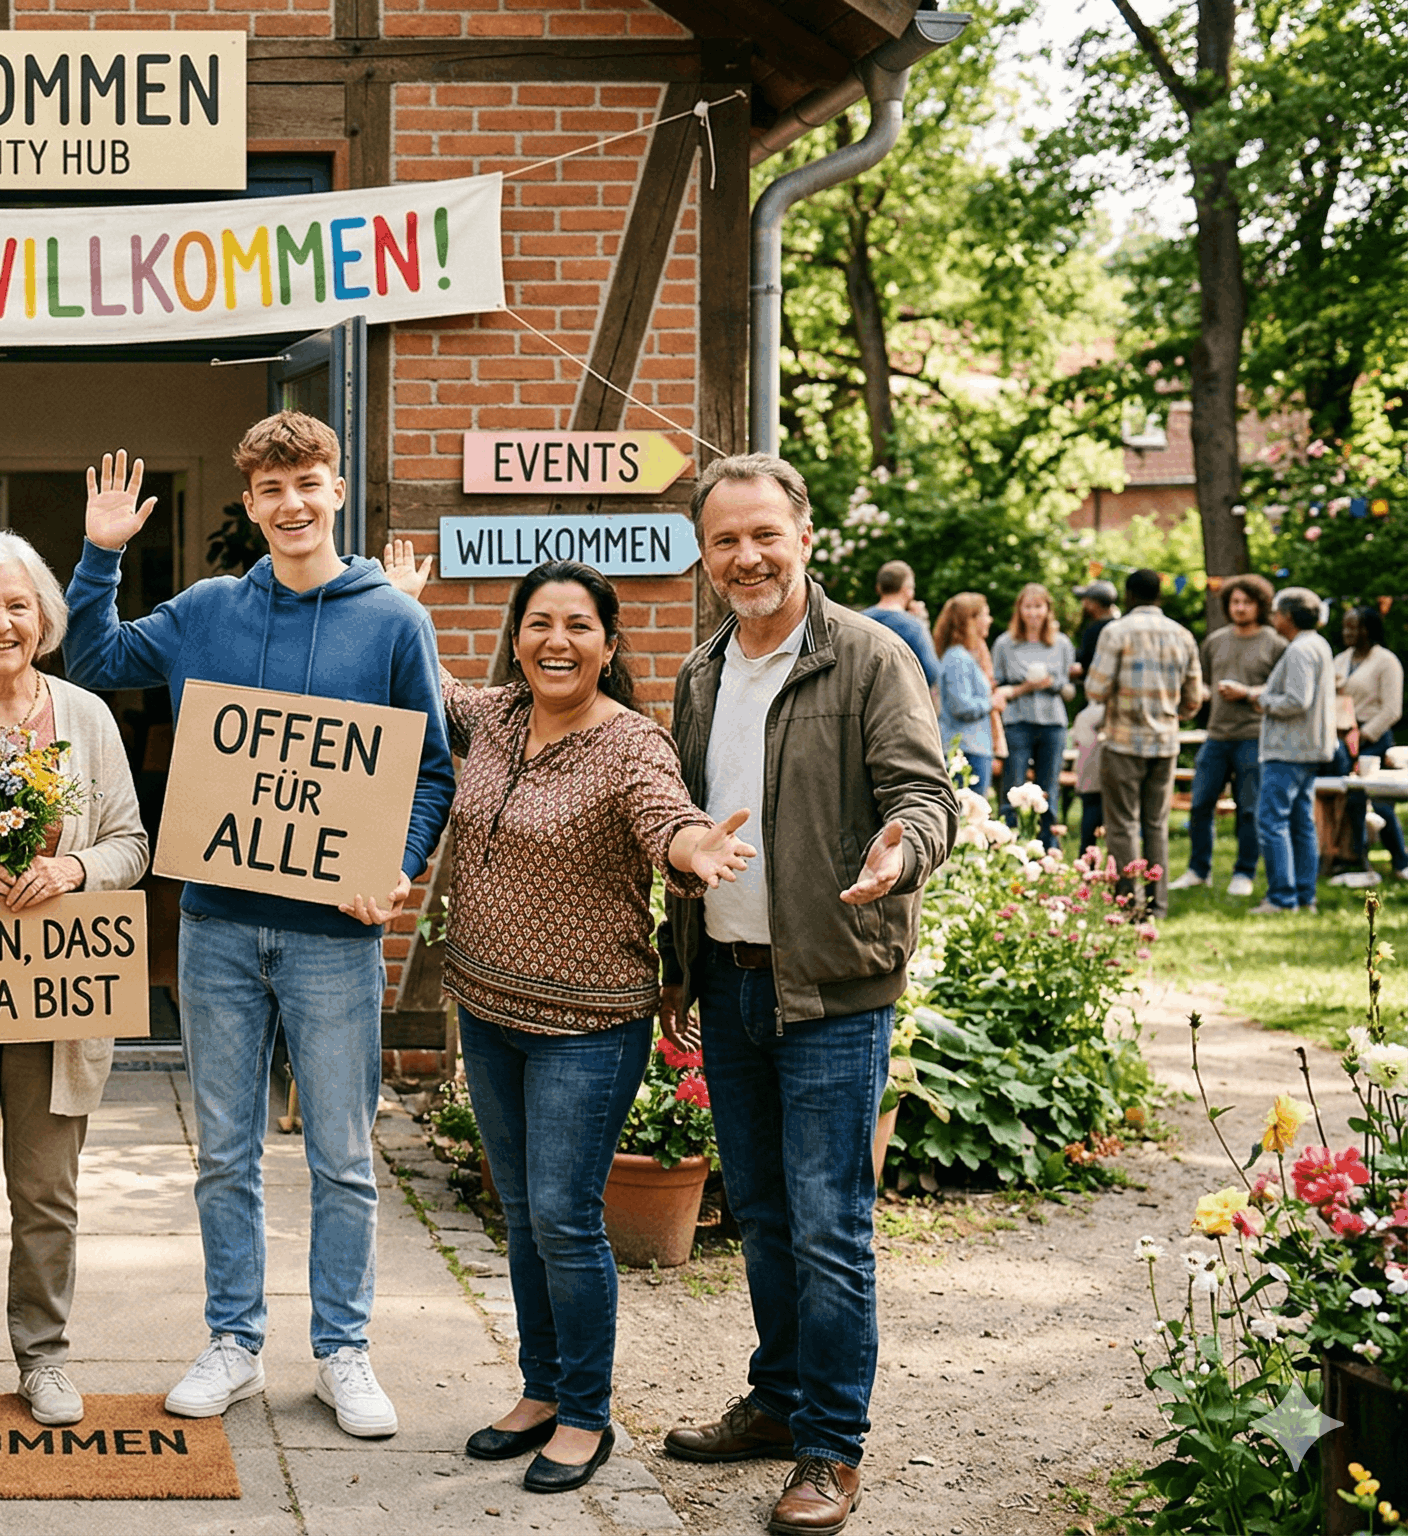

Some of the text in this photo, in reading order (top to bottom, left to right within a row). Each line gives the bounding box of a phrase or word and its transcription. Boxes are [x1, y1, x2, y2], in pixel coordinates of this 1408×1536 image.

[63, 139, 130, 175] HUB
[494, 442, 639, 483] EVENTS
[456, 526, 671, 565] WILLKOMMEN
[213, 703, 383, 776] OFFEN
[253, 769, 321, 816] FÜR
[203, 812, 349, 882] ALLE
[43, 915, 135, 959] DASS
[33, 974, 121, 1019] BIST
